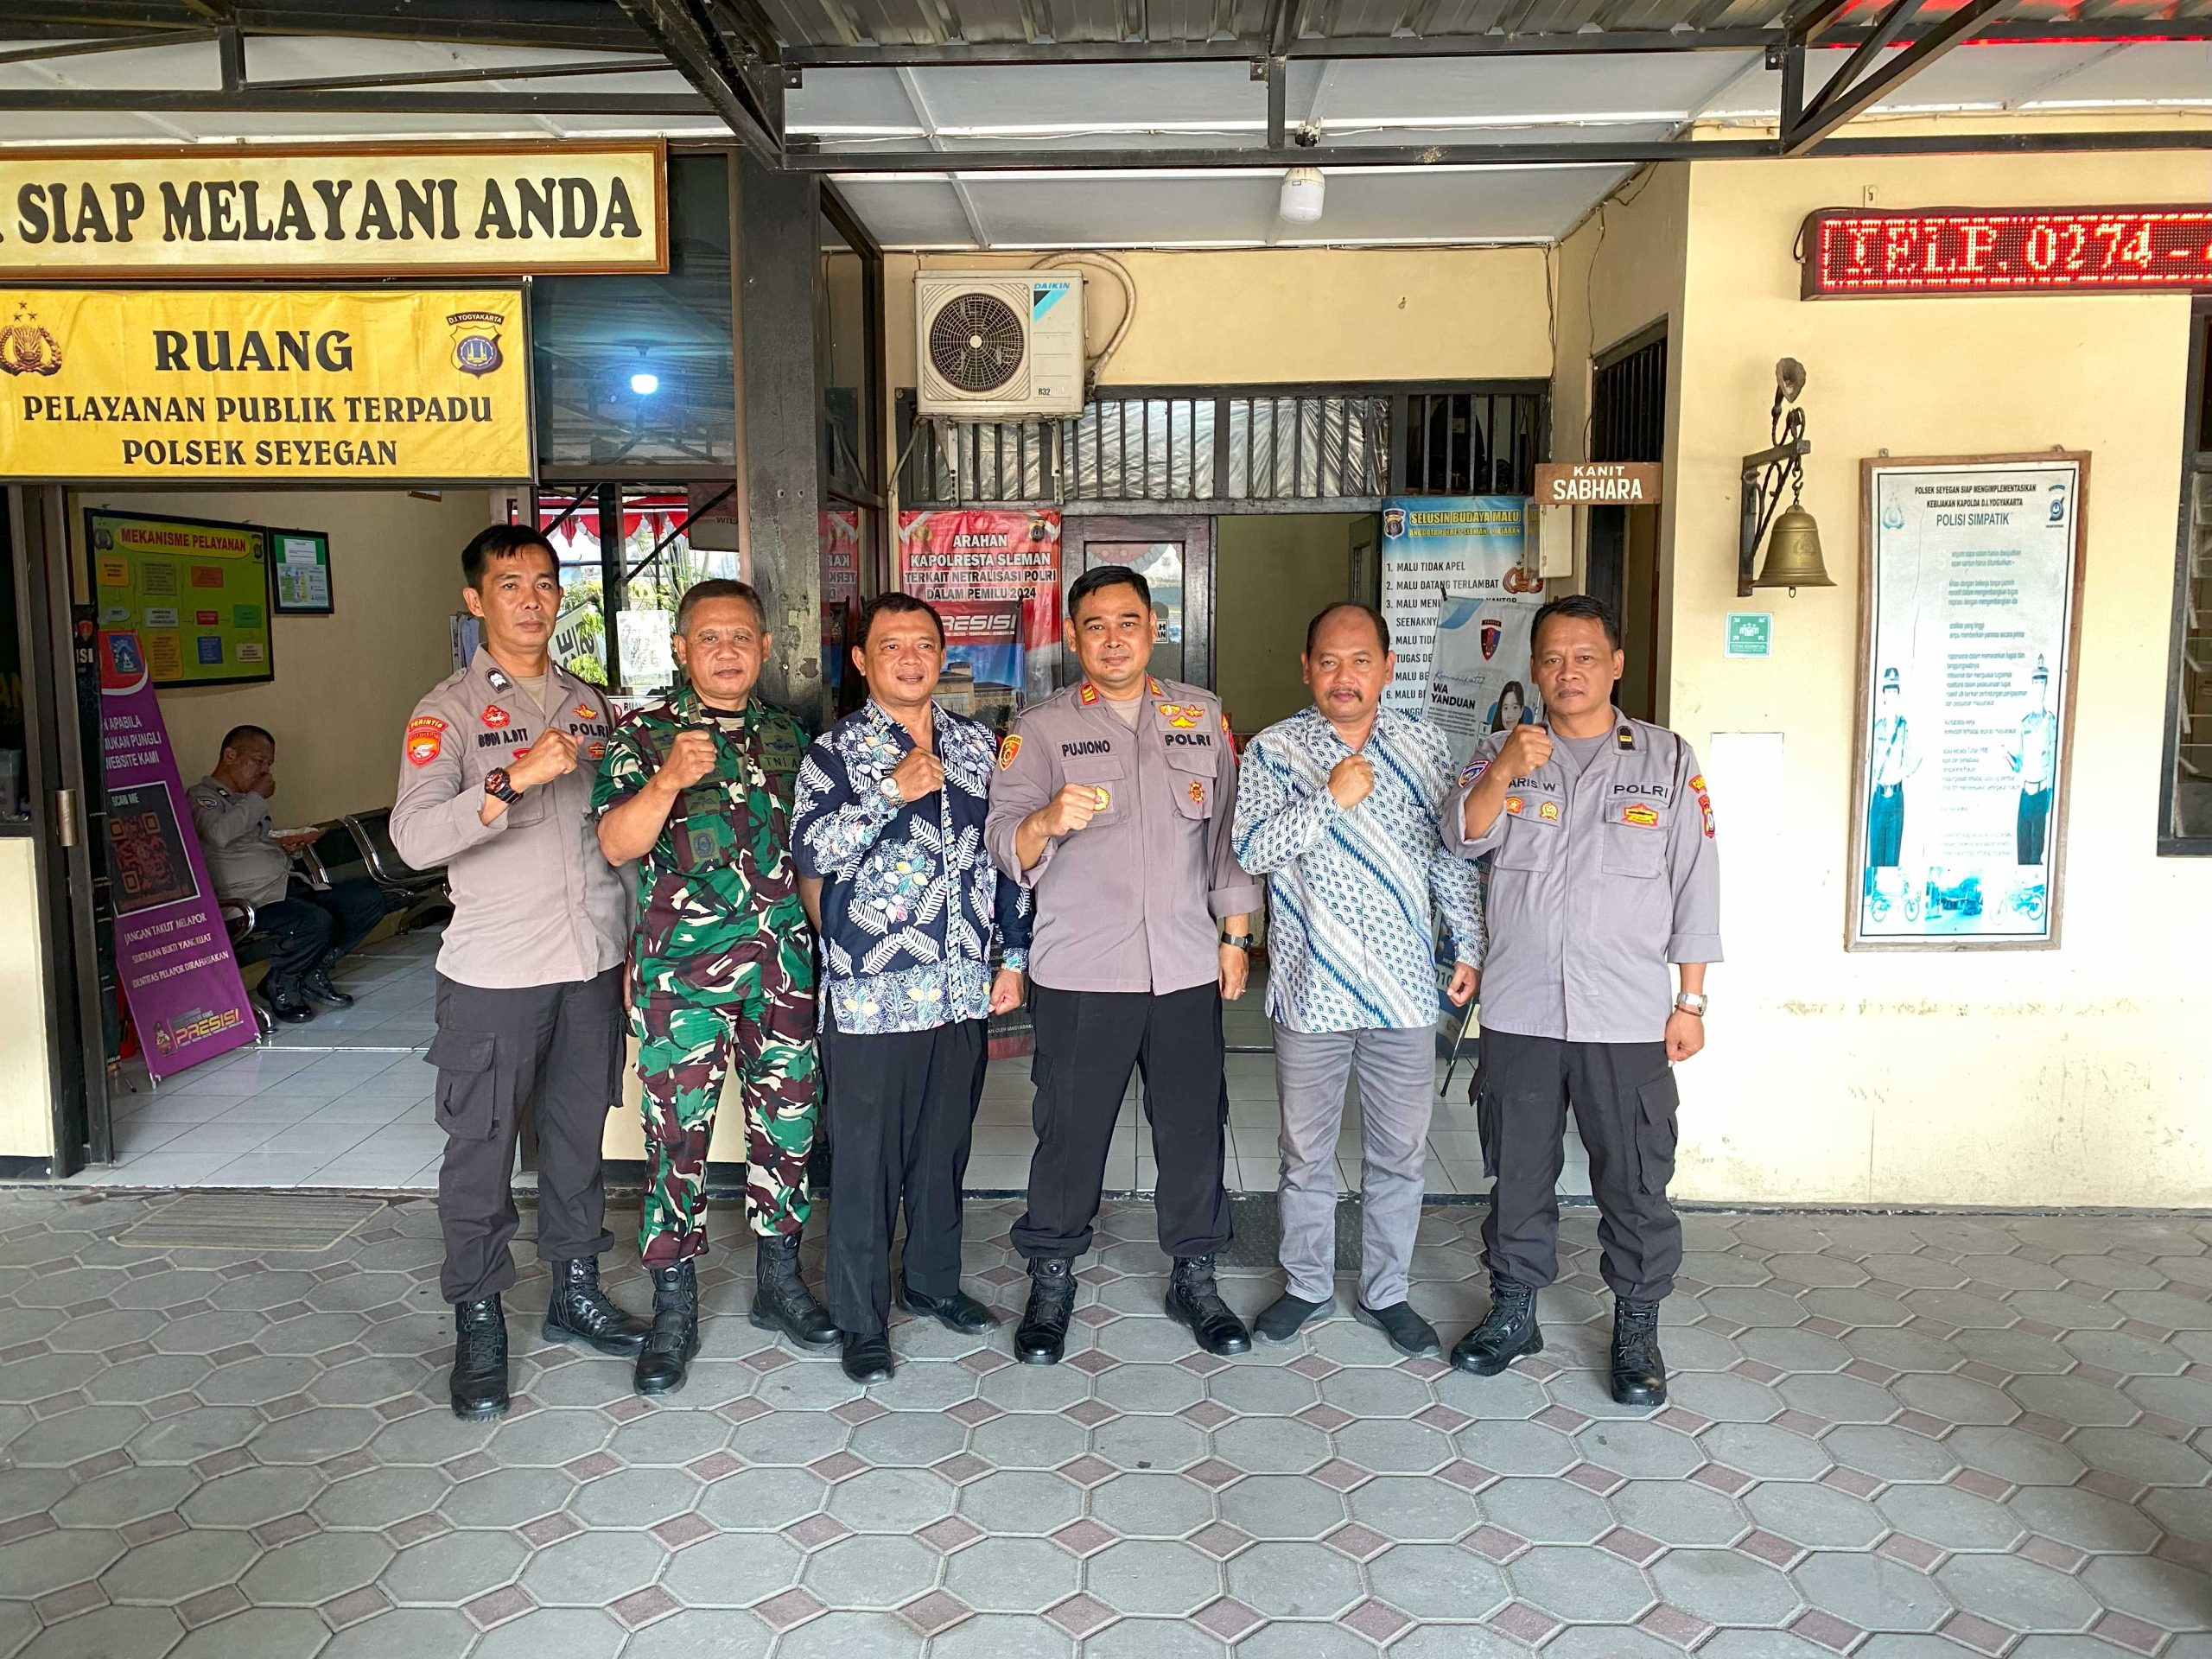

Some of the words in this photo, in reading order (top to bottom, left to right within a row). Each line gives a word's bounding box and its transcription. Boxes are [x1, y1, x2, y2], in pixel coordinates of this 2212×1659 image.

[17, 182, 145, 244] SIAP
[159, 178, 460, 242] MELAYANI
[475, 176, 642, 239] ANDA
[2028, 222, 2152, 271] 0274
[153, 329, 353, 372] RUANG
[1038, 388, 1052, 397] R32
[23, 396, 206, 423] PELAYANAN
[216, 397, 337, 423] PUBLIK
[344, 396, 493, 423] TERPADU
[122, 439, 246, 466] POLSEK
[255, 439, 398, 466] SEYEGAN
[1573, 466, 1625, 476] KANIT
[1553, 479, 1643, 500] SABHARA
[1915, 486, 1935, 494] POLSEK
[1974, 484, 2037, 493] MENGIMPLEMENTASIKAN
[1927, 499, 1955, 508] KEBIJAKAN
[1410, 512, 1451, 524] SELUSIN
[1452, 511, 1491, 524] BUDAYA
[1491, 510, 1519, 522] MALU
[1936, 514, 1966, 526] POLISI
[1967, 512, 2009, 525] SIMPATIK
[121, 528, 190, 547] MEKANISME
[192, 532, 246, 552] PELAYANAN
[953, 534, 1007, 548] ARAHAN
[910, 553, 993, 568] KAPOLRESTA
[997, 552, 1051, 567] SLEMAN
[1387, 563, 1393, 572] 1.
[1396, 563, 1418, 572] MALU
[1421, 562, 1444, 571] TIDAK
[1446, 562, 1465, 570] APEL
[905, 570, 950, 583] TERKAIT
[951, 570, 1021, 583] NETRALISASI
[1024, 569, 1056, 582] POLRI
[1387, 582, 1393, 590] 2.
[1396, 581, 1418, 590] MALU
[1421, 580, 1451, 589] DATANG
[1452, 579, 1499, 588] TERLAMBAT
[926, 588, 963, 601] DALAM
[966, 588, 1007, 600] PEMILU
[1009, 587, 1036, 600] 2024
[1387, 600, 1393, 608] 3.
[1396, 599, 1418, 608] MALU
[942, 613, 1018, 631] RESISI
[1396, 636, 1417, 645] MALU
[1397, 654, 1420, 663] TUGAS
[1395, 672, 1416, 681] MALU
[1395, 690, 1415, 699] MALU
[1433, 683, 1448, 694] WA
[1431, 694, 1476, 709] YANDUAN
[110, 715, 143, 730] APABILA
[569, 723, 609, 738] POLRI
[130, 731, 162, 747] PUNGLI
[1166, 734, 1211, 747] POLRI
[1062, 740, 1111, 757] PUJIONO
[138, 751, 160, 766] KAMI
[1543, 782, 1556, 792] W
[1614, 785, 1668, 798] POLRI
[124, 927, 152, 946] JANGAN
[151, 921, 175, 936] TAKUT
[175, 1007, 239, 1045] PRESISI
